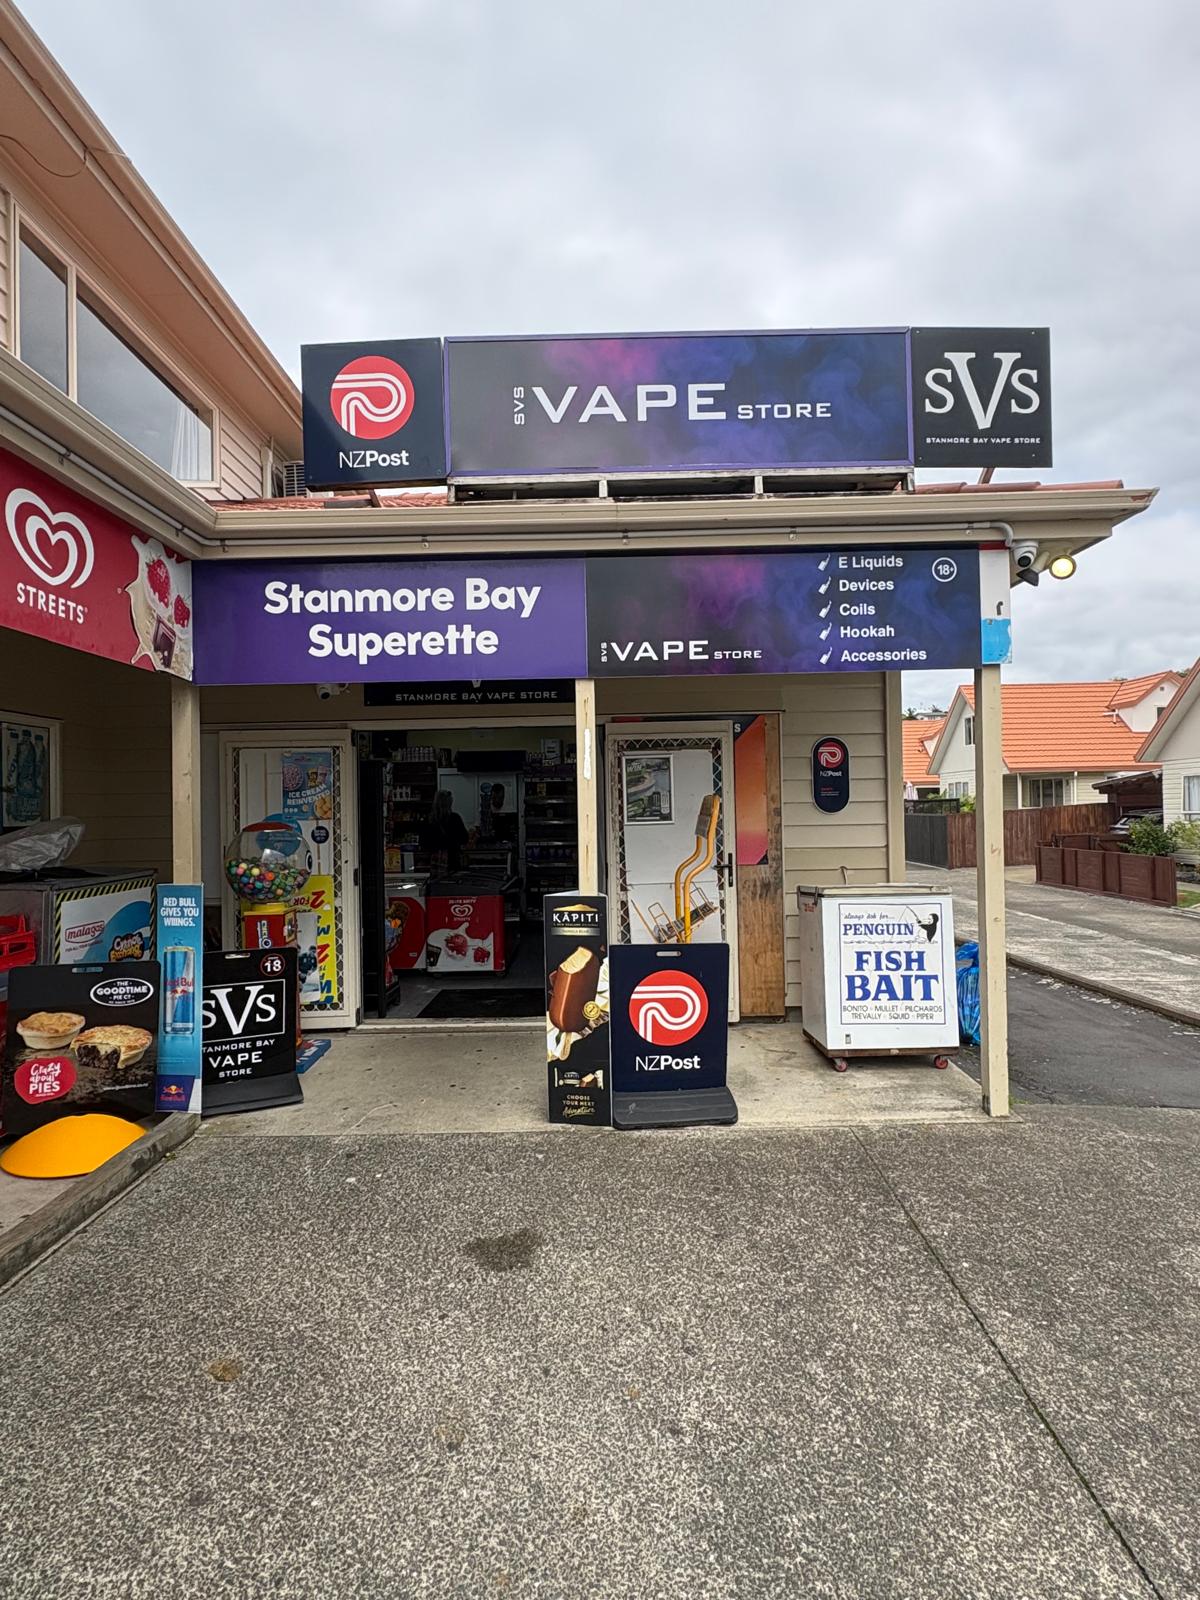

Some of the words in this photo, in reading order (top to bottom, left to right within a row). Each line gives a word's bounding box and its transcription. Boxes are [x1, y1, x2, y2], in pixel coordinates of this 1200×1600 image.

[924, 351, 1040, 430] SVS
[513, 386, 525, 425] SVS
[531, 383, 727, 424] VAPE
[737, 402, 832, 420] STORE
[339, 450, 409, 469] NZPost
[838, 556, 848, 568] E
[852, 555, 904, 571] Liquids
[839, 579, 894, 592] Devices
[16, 582, 84, 624] STREETS
[263, 581, 455, 615] Stanmore
[465, 577, 541, 618] Bay
[839, 603, 876, 616] Coils
[840, 625, 895, 639] Hookah
[307, 624, 499, 665] Superette
[611, 640, 709, 662] VAPE
[713, 649, 762, 660] STORE
[840, 648, 927, 663] Accessories
[394, 692, 457, 702] STANMORE
[461, 692, 484, 701] BAY
[486, 691, 516, 701] VAPE
[520, 691, 558, 700] STORE
[163, 897, 177, 907] RED
[178, 897, 197, 907] BULL
[160, 907, 182, 917] GIVES
[183, 907, 199, 917] YOU
[842, 923, 914, 936] PENGUIN
[264, 959, 282, 972] 18
[854, 950, 926, 972] FISH
[96, 985, 148, 996] GOODTIME
[845, 974, 939, 1001] BAIT
[202, 985, 276, 1036] SVS
[843, 1005, 869, 1013] BONITO
[905, 1005, 943, 1013] PILCHARDS
[851, 1012, 882, 1020] TREVALLY
[889, 1012, 910, 1020] SQUID
[916, 1012, 934, 1020] PIPER
[202, 1041, 252, 1053] TANMORE
[256, 1038, 276, 1047] BAY
[208, 1051, 262, 1068] VAPE
[635, 1054, 701, 1072] NZPost
[30, 1062, 61, 1077] Crazy
[218, 1068, 253, 1078] STORE
[29, 1081, 61, 1095] PIES
